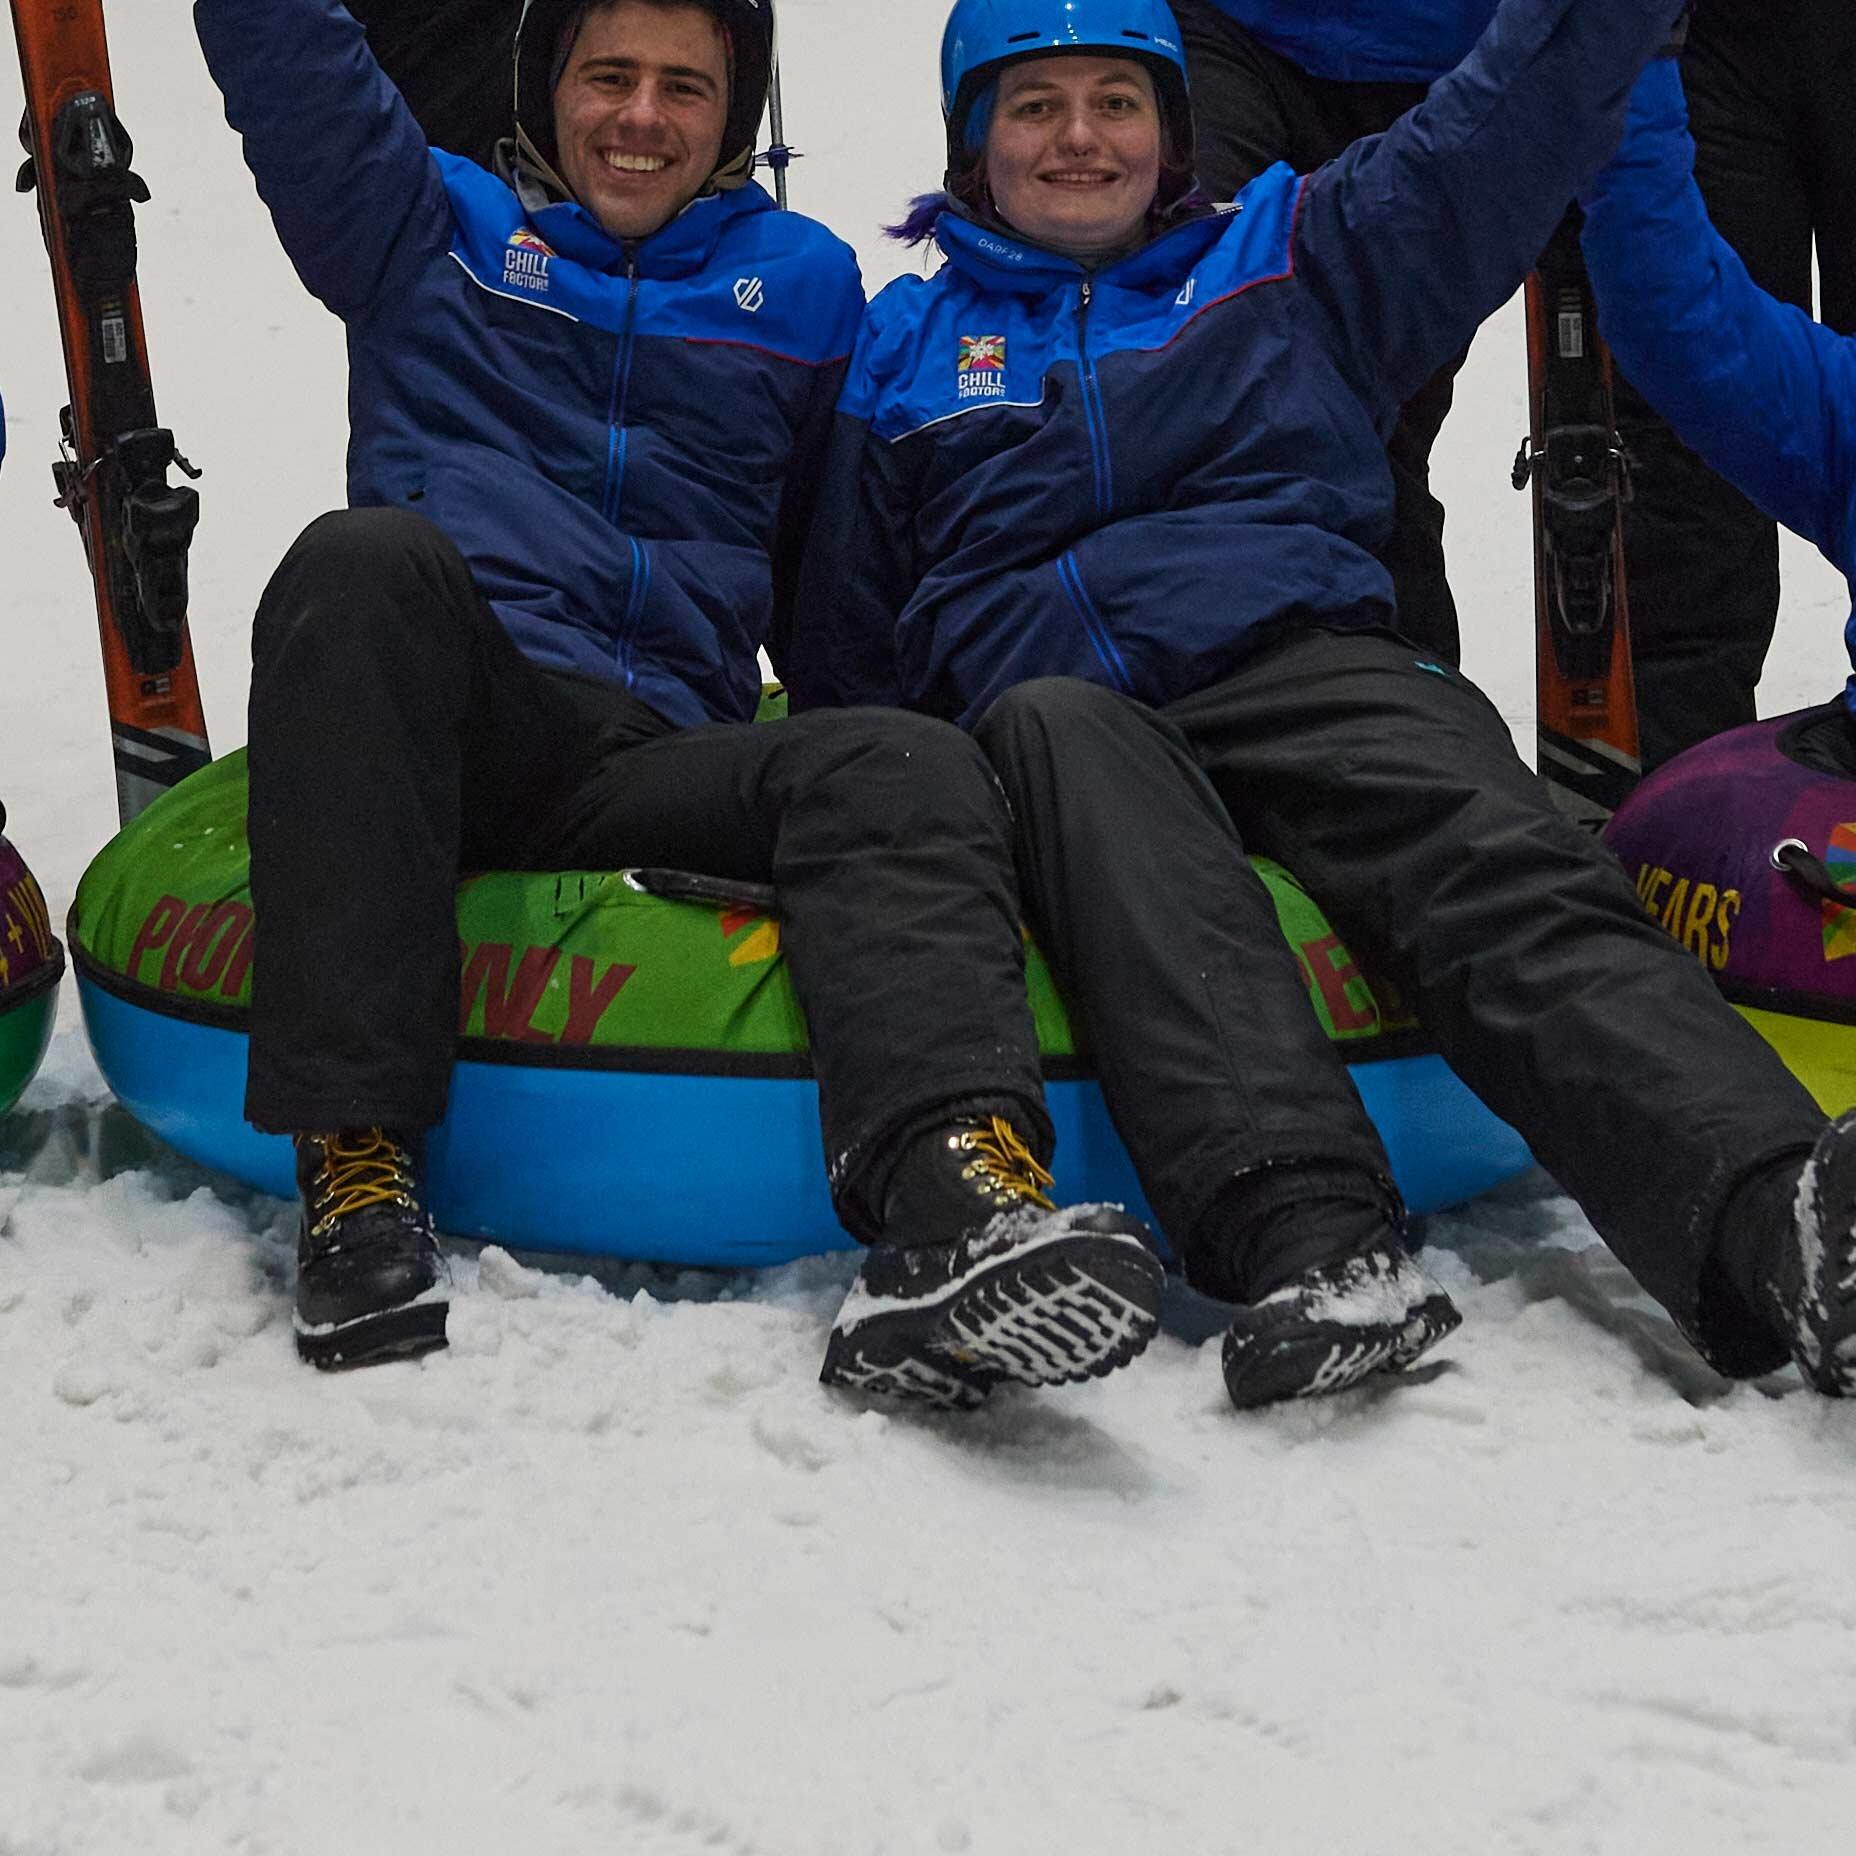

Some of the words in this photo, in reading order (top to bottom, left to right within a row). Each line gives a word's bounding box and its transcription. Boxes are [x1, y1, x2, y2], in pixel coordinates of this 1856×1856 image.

[504, 248, 548, 277] CHILL
[958, 371, 1006, 390] CHILL
[457, 941, 637, 1044] NLY
